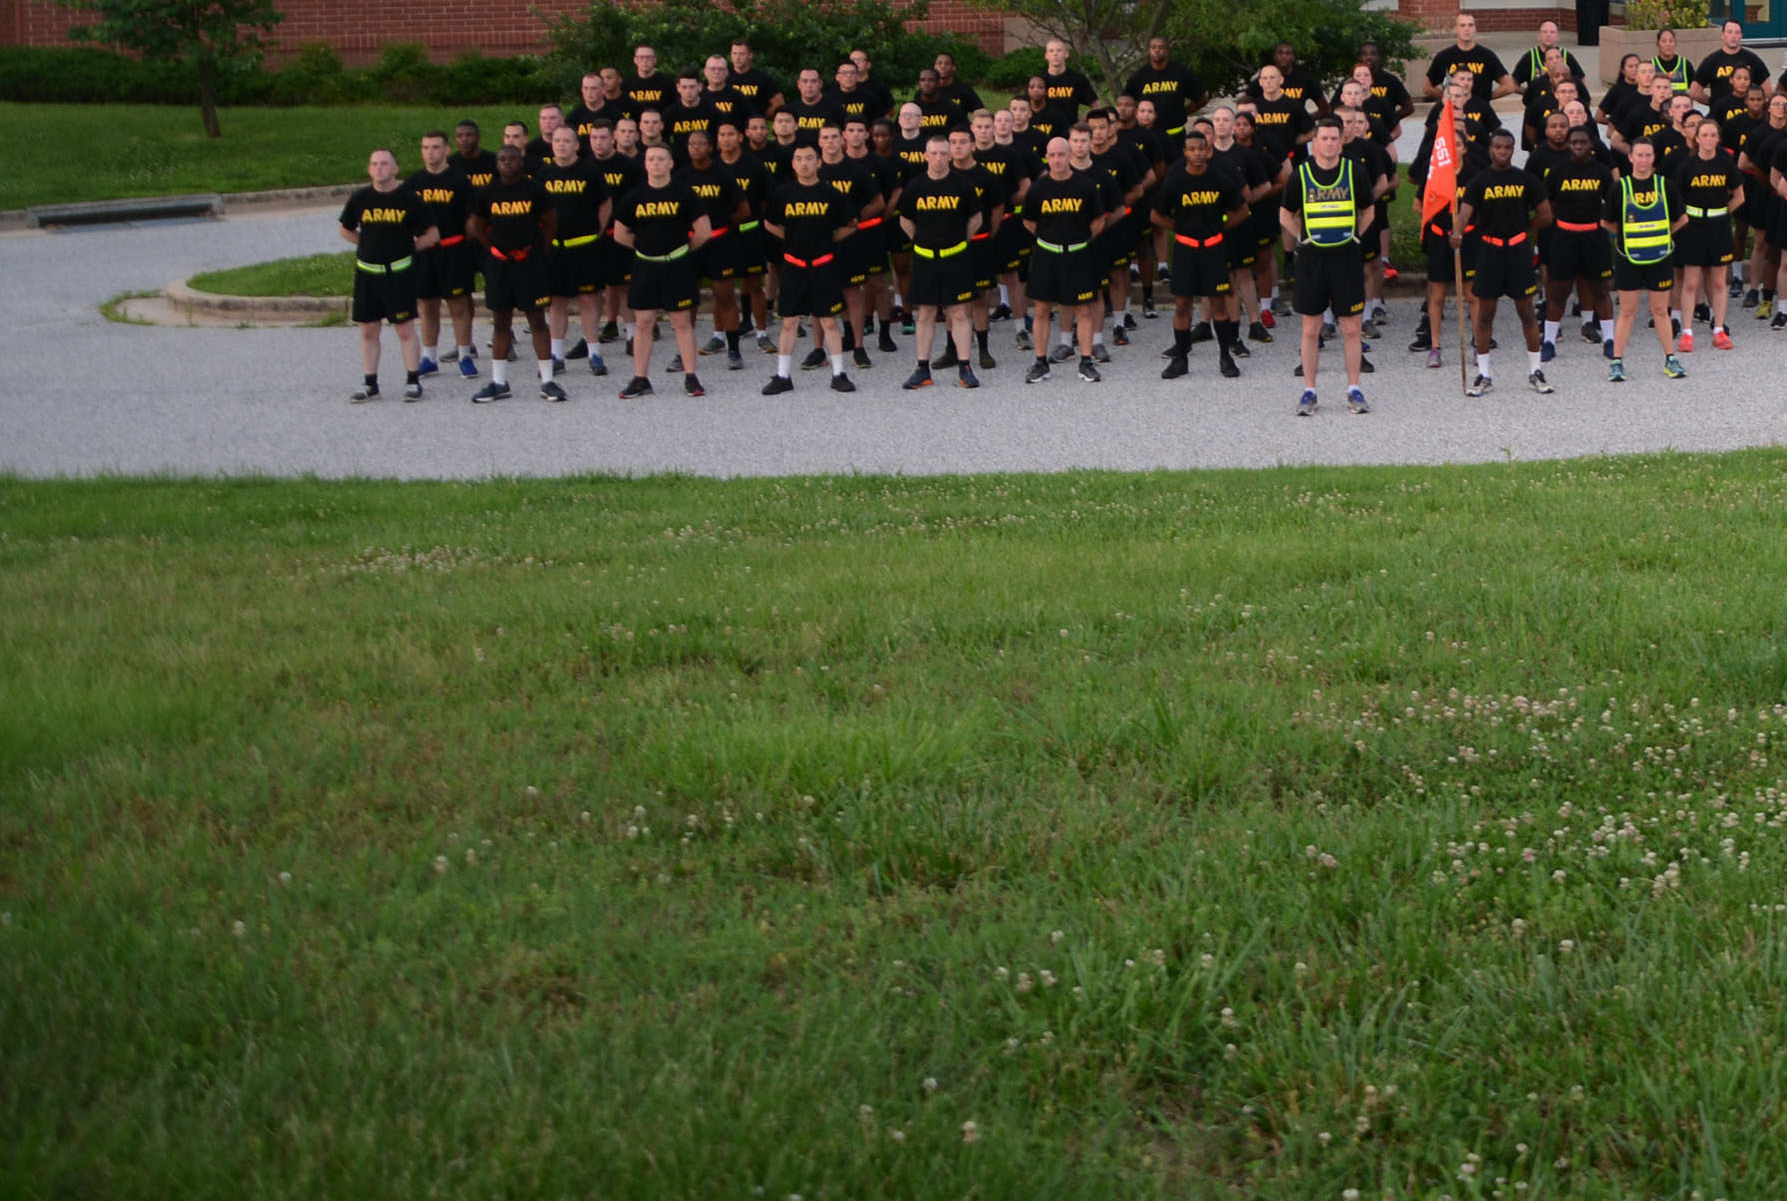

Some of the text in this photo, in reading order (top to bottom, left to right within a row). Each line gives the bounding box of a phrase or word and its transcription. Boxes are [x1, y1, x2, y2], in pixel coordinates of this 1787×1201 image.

[1448, 62, 1485, 75] AMY
[1716, 65, 1734, 78] AR
[1047, 86, 1074, 98] RMY
[1142, 80, 1178, 95] ARMY
[1370, 86, 1388, 98] MY
[715, 102, 733, 112] MY
[846, 102, 864, 114] MY
[798, 116, 826, 129] RMY
[919, 114, 948, 128] RMY
[1255, 112, 1290, 125] ARMY
[673, 119, 709, 133] ARMY
[1642, 123, 1666, 137] AR
[899, 151, 927, 163] RMY
[981, 161, 1006, 175] MY
[471, 174, 493, 186] MY
[545, 179, 587, 193] ARMY
[604, 173, 623, 185] MY
[1560, 178, 1601, 192] ARMY
[1690, 174, 1727, 187] ARMY
[692, 184, 721, 197] RMY
[831, 180, 852, 193] MY
[1483, 184, 1525, 200] ARMY
[416, 188, 454, 203] RMY
[1181, 190, 1220, 207] ARMY
[1634, 191, 1657, 204] RM
[491, 200, 532, 216] ARMY
[635, 201, 679, 218] ARMY
[784, 201, 829, 217] ARMY
[916, 195, 960, 211] ARMY
[1041, 198, 1083, 214] ARMY
[361, 208, 406, 222] ARMY
